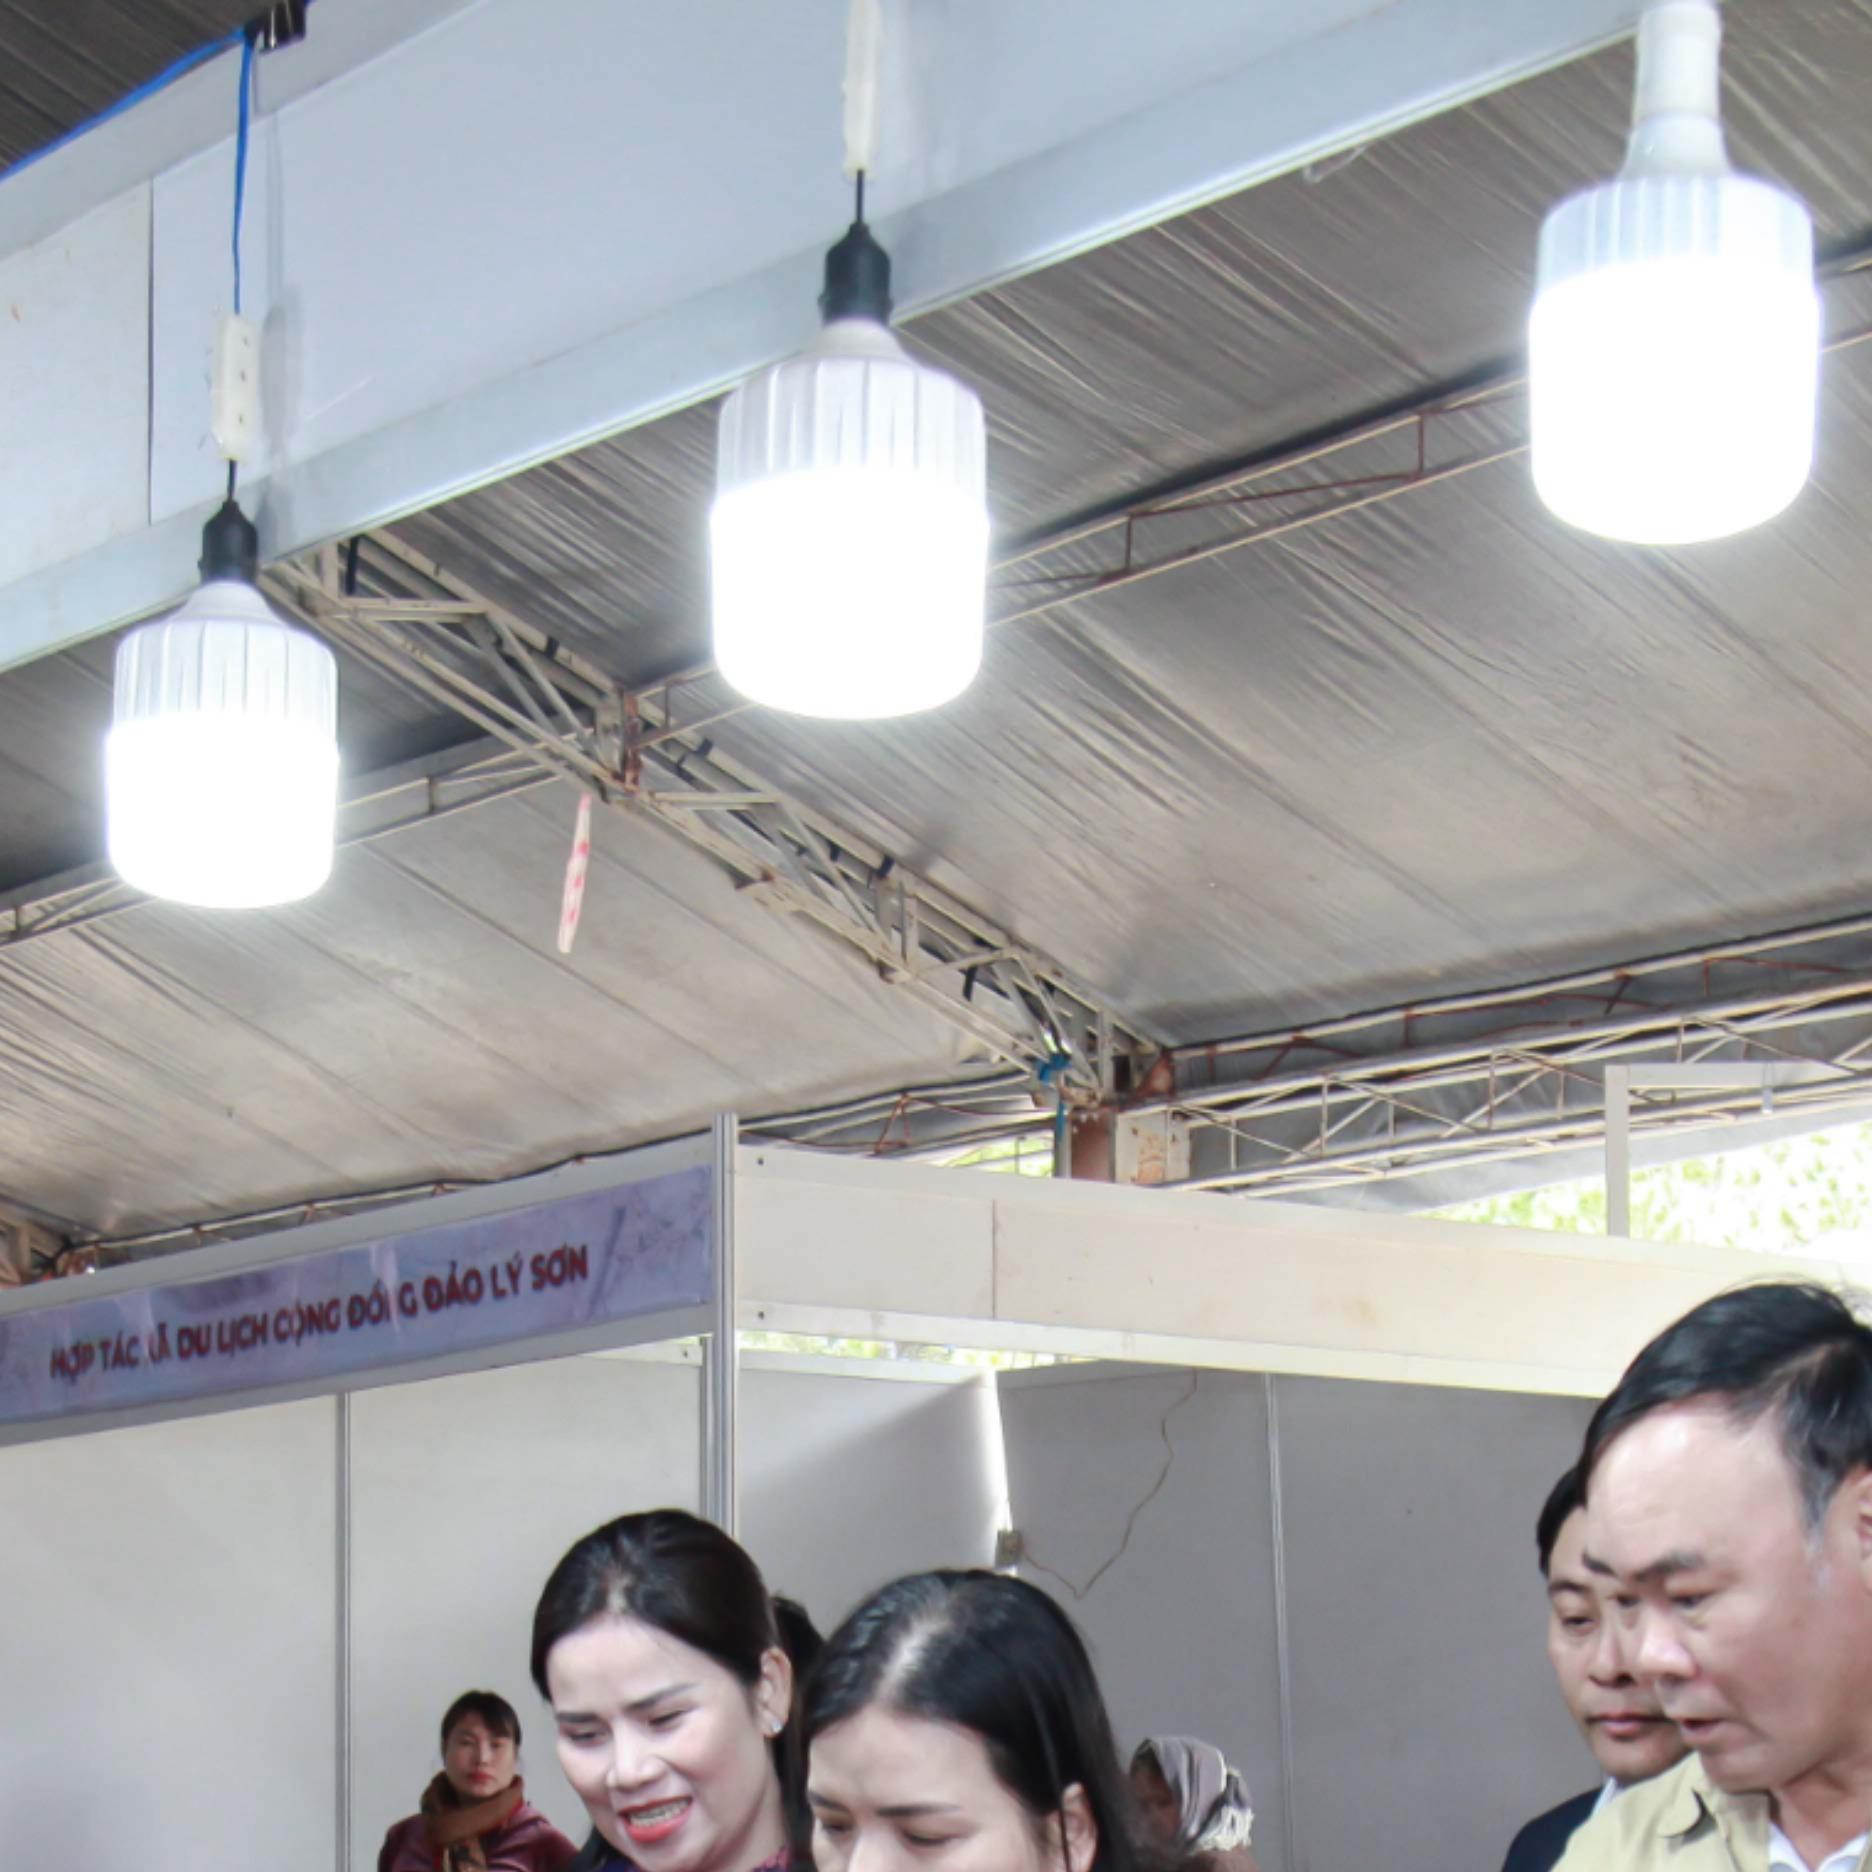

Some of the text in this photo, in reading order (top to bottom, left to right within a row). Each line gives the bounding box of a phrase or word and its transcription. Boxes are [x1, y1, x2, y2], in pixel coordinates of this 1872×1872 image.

[49, 1341, 95, 1388] HỢP
[100, 1331, 140, 1370] TÁC
[178, 1323, 211, 1361] DU
[217, 1313, 268, 1359] LỊCH
[346, 1276, 419, 1327] ĐỒG
[422, 1260, 483, 1312] ĐẢO
[489, 1256, 524, 1299] LÝ
[531, 1244, 589, 1292] SƠN
